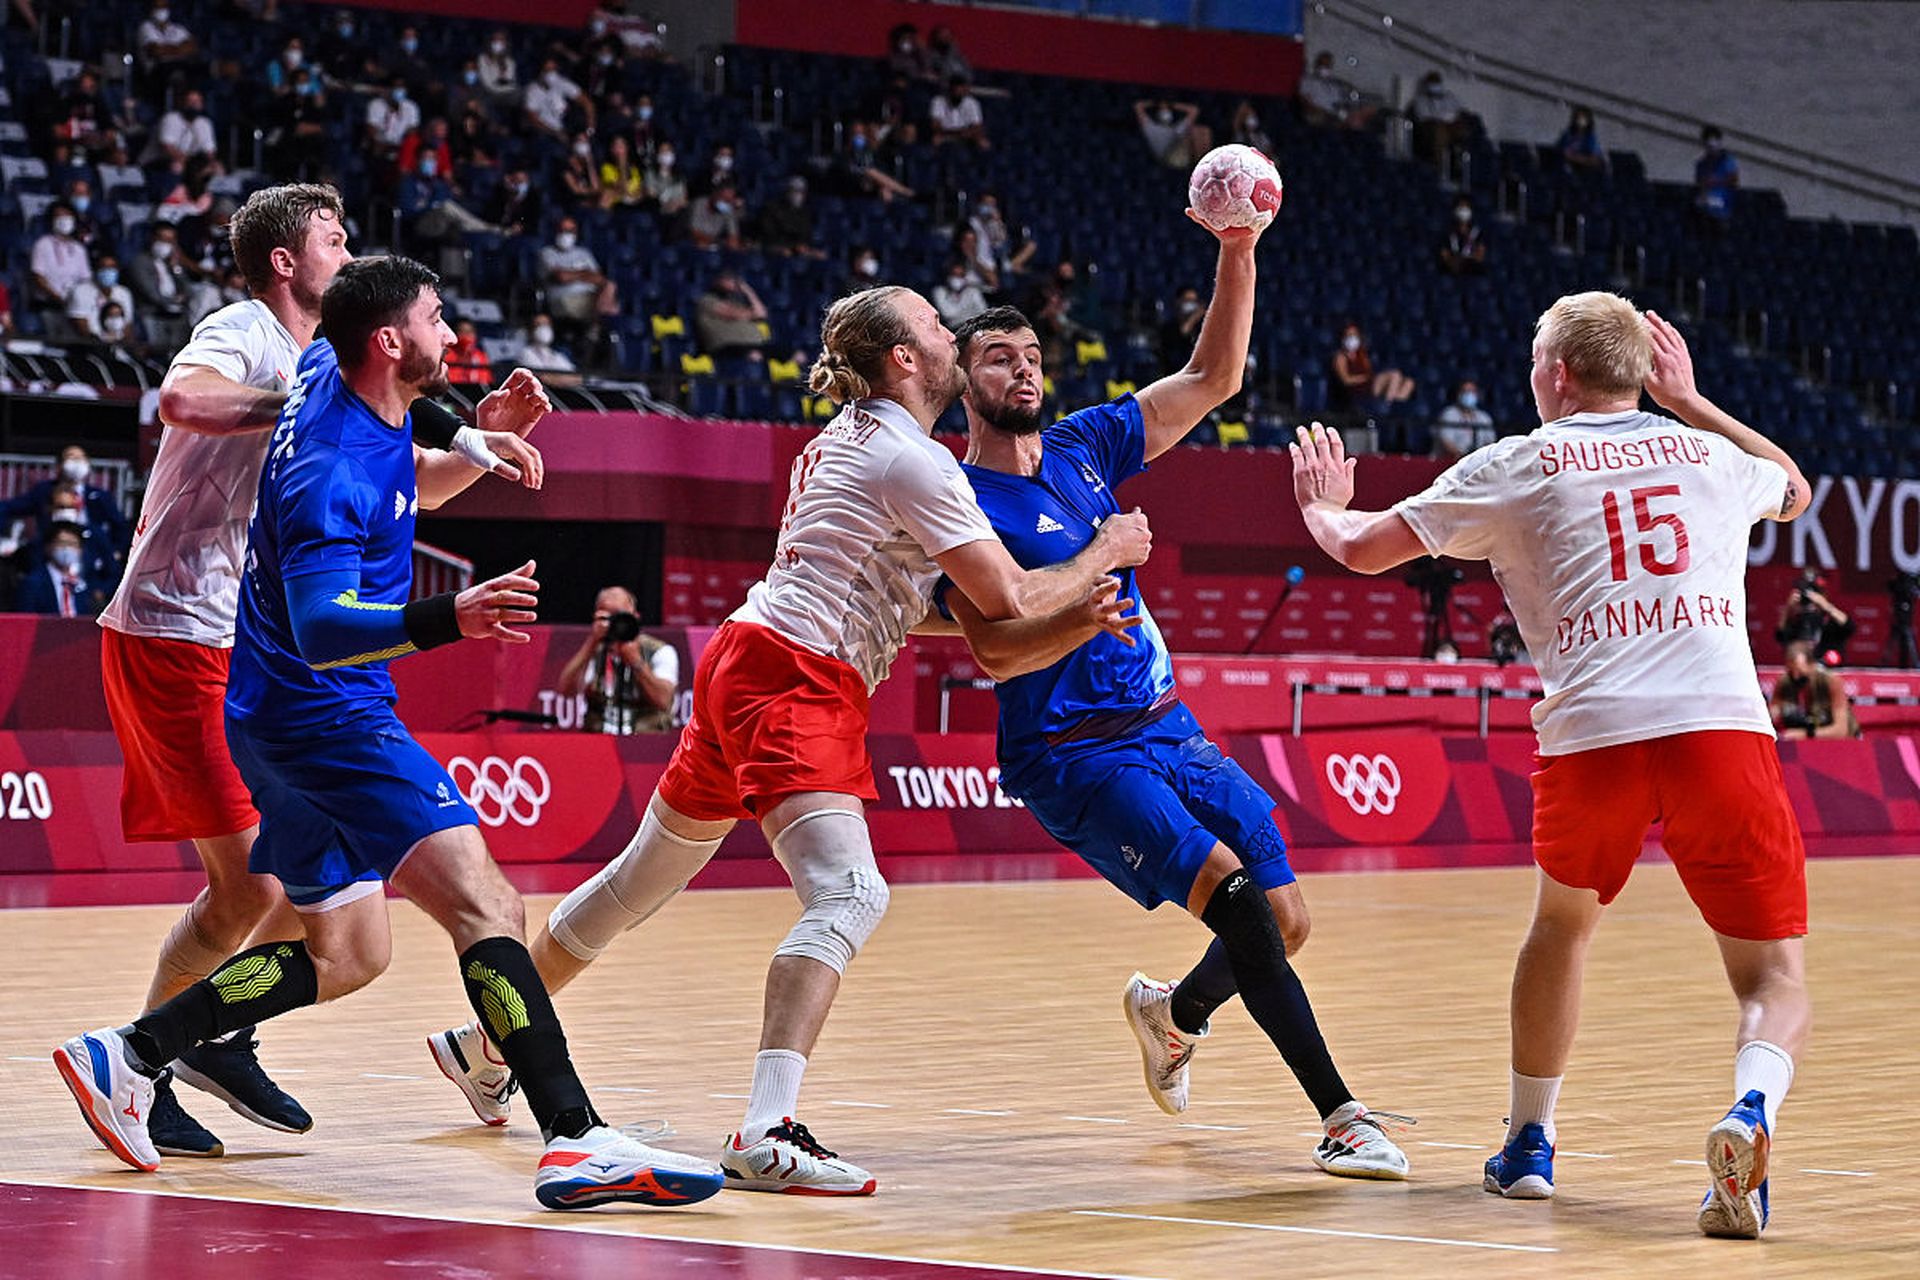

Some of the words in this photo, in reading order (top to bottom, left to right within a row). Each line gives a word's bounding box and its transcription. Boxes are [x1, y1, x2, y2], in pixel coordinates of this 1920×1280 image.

[1540, 434, 1710, 476] SAUGSTRUP
[1601, 484, 1690, 582] 15
[1557, 594, 1734, 655] DANMARK
[0, 771, 53, 820] 20
[888, 766, 989, 809] TOKYO
